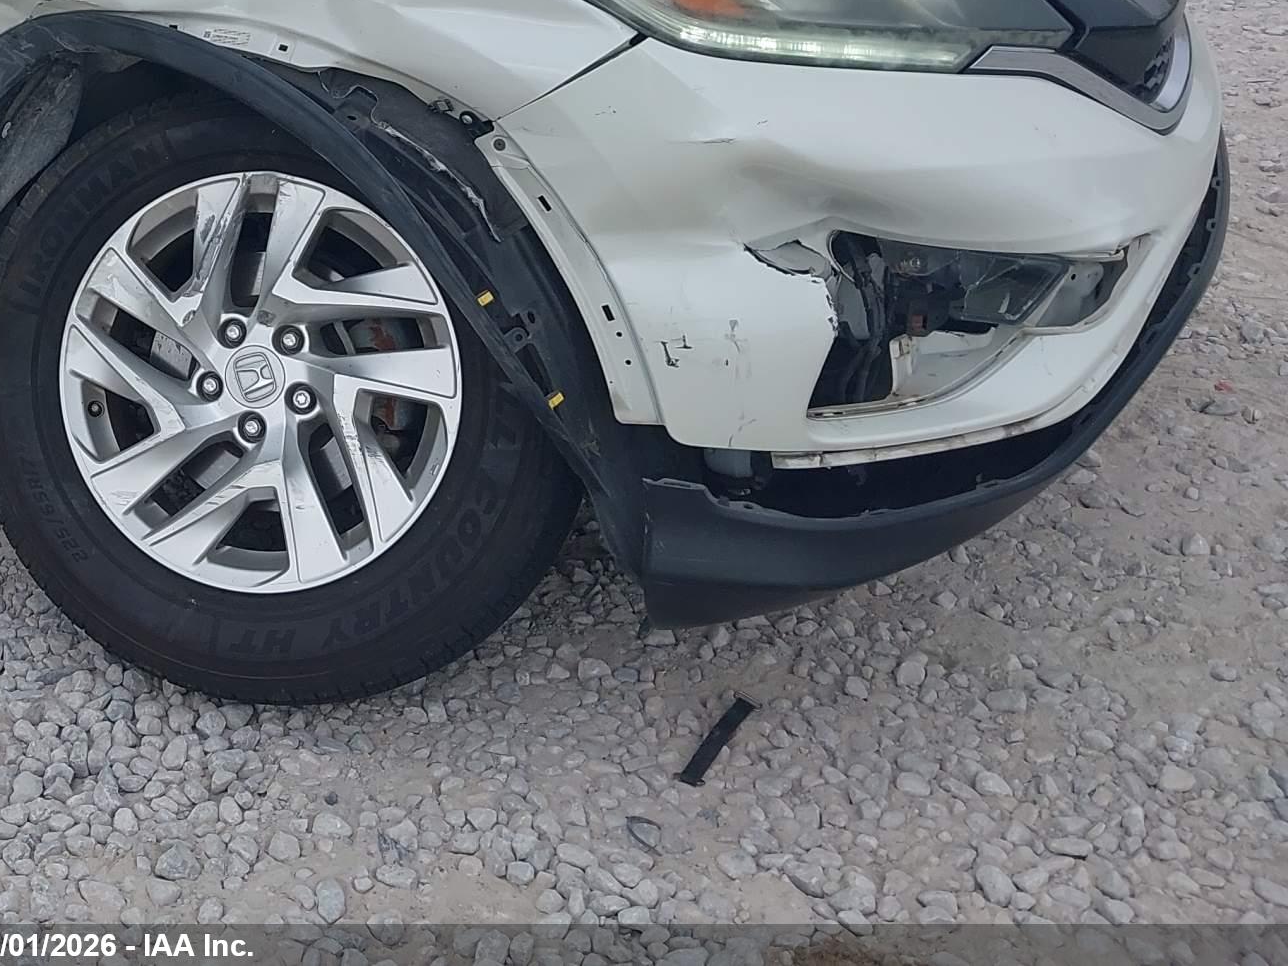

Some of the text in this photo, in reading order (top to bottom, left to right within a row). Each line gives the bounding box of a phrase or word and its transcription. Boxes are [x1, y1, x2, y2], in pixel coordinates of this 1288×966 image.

[18, 141, 166, 297] IRONMAN
[321, 464, 506, 650] COUNTRY
[229, 626, 296, 655] HT
